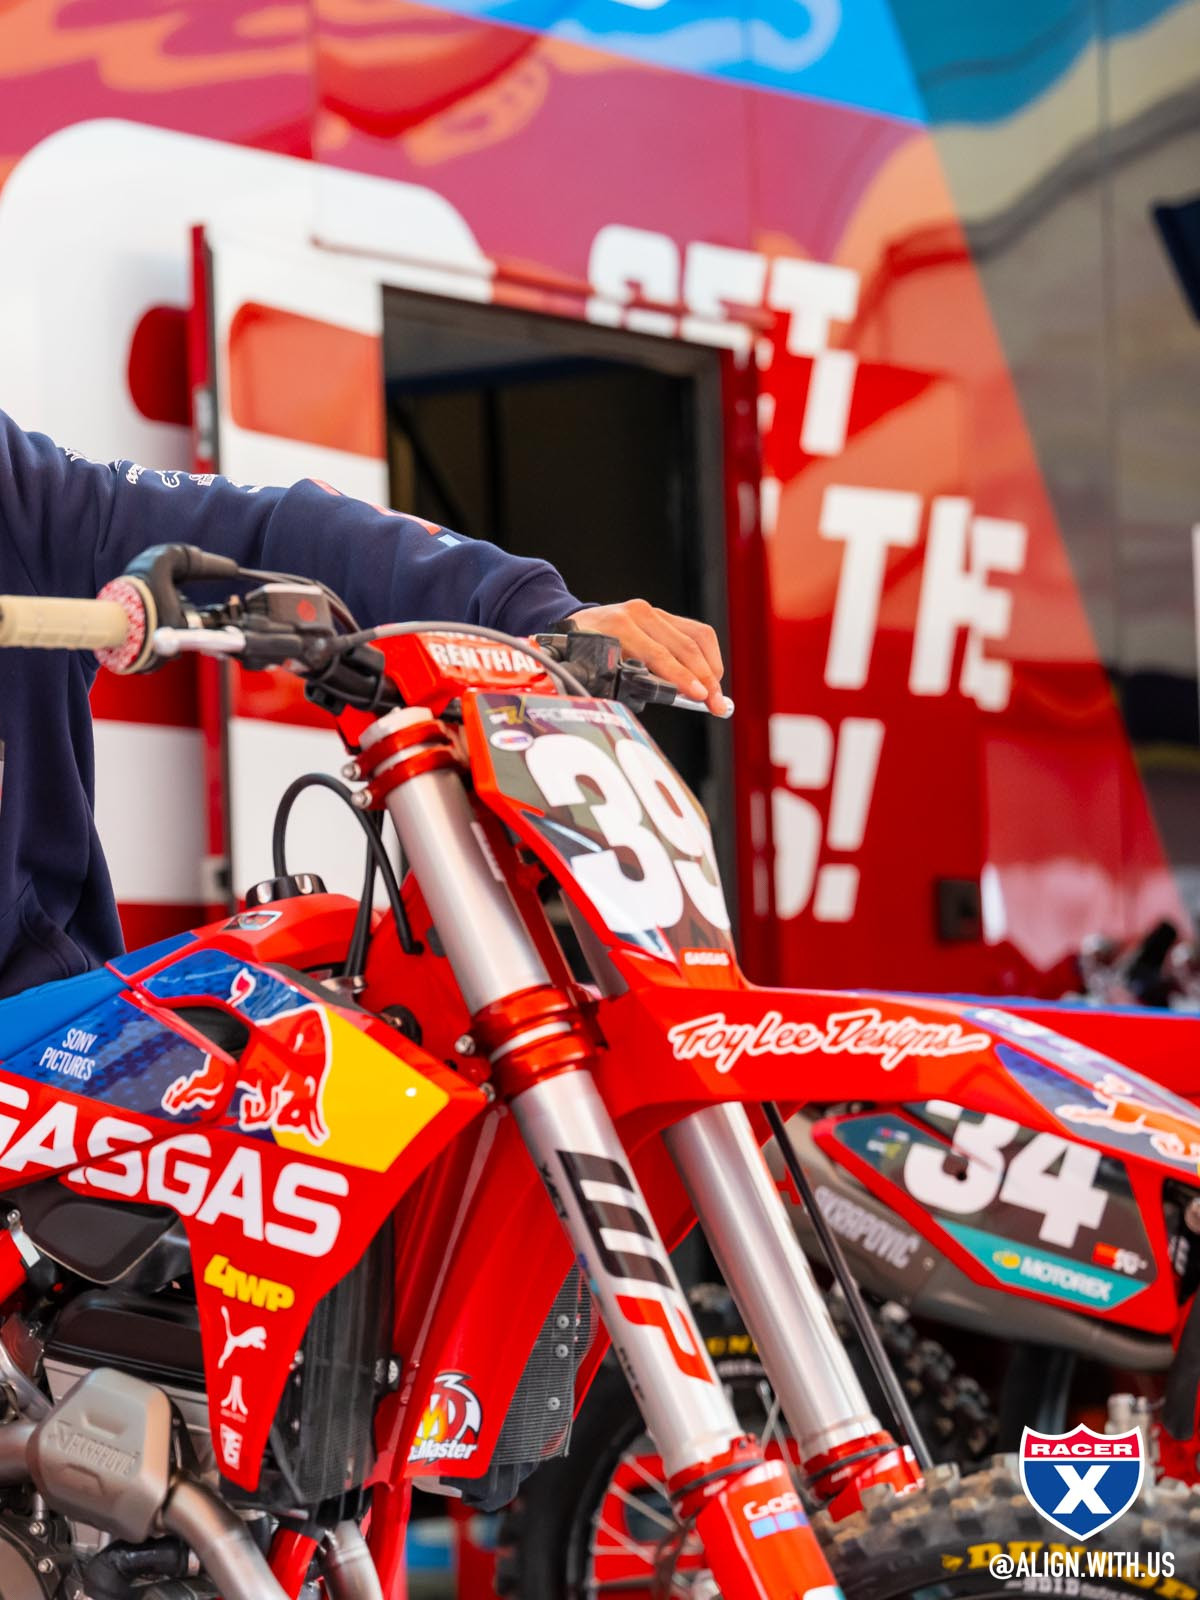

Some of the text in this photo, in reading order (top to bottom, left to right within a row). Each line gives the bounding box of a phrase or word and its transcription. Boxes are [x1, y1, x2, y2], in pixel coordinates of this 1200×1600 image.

[428, 643, 546, 673] RENTHAL
[525, 733, 732, 932] 39
[39, 1046, 96, 1081] PICTURES
[62, 1027, 98, 1054] SONY
[667, 1007, 992, 1074] Troy Lee Designs
[904, 1099, 1109, 1249] 34
[203, 1253, 296, 1312] 4WP
